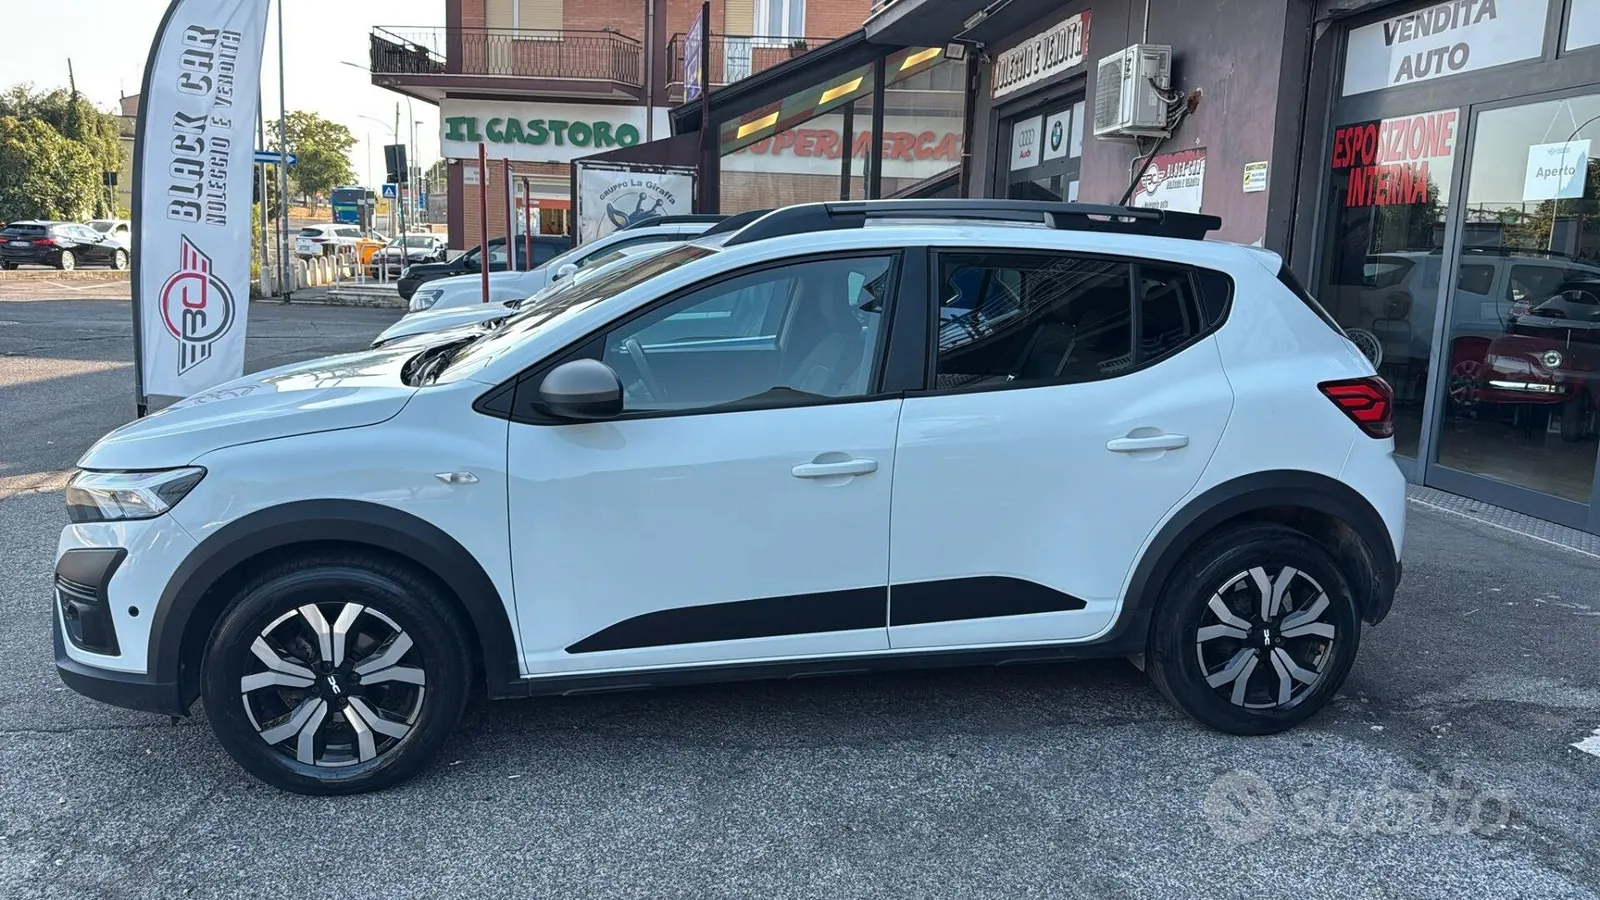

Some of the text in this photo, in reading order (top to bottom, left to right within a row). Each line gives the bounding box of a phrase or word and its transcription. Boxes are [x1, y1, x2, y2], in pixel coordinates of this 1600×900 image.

[1383, 0, 1497, 47] VENDITA
[1033, 41, 1041, 75] E
[1042, 20, 1083, 71] VENDITA
[1393, 42, 1470, 83] AUTO
[167, 25, 220, 223] BLACK CAR
[206, 30, 241, 226] NOLEGGIO E VENDITA
[445, 116, 640, 148] IL CASTORO
[1332, 112, 1456, 169] ESPOSIZIONE
[600, 179, 676, 205] GRUPPO La Giraffa
[1346, 161, 1428, 208] INTERNA
[1535, 165, 1576, 180] Aperto
